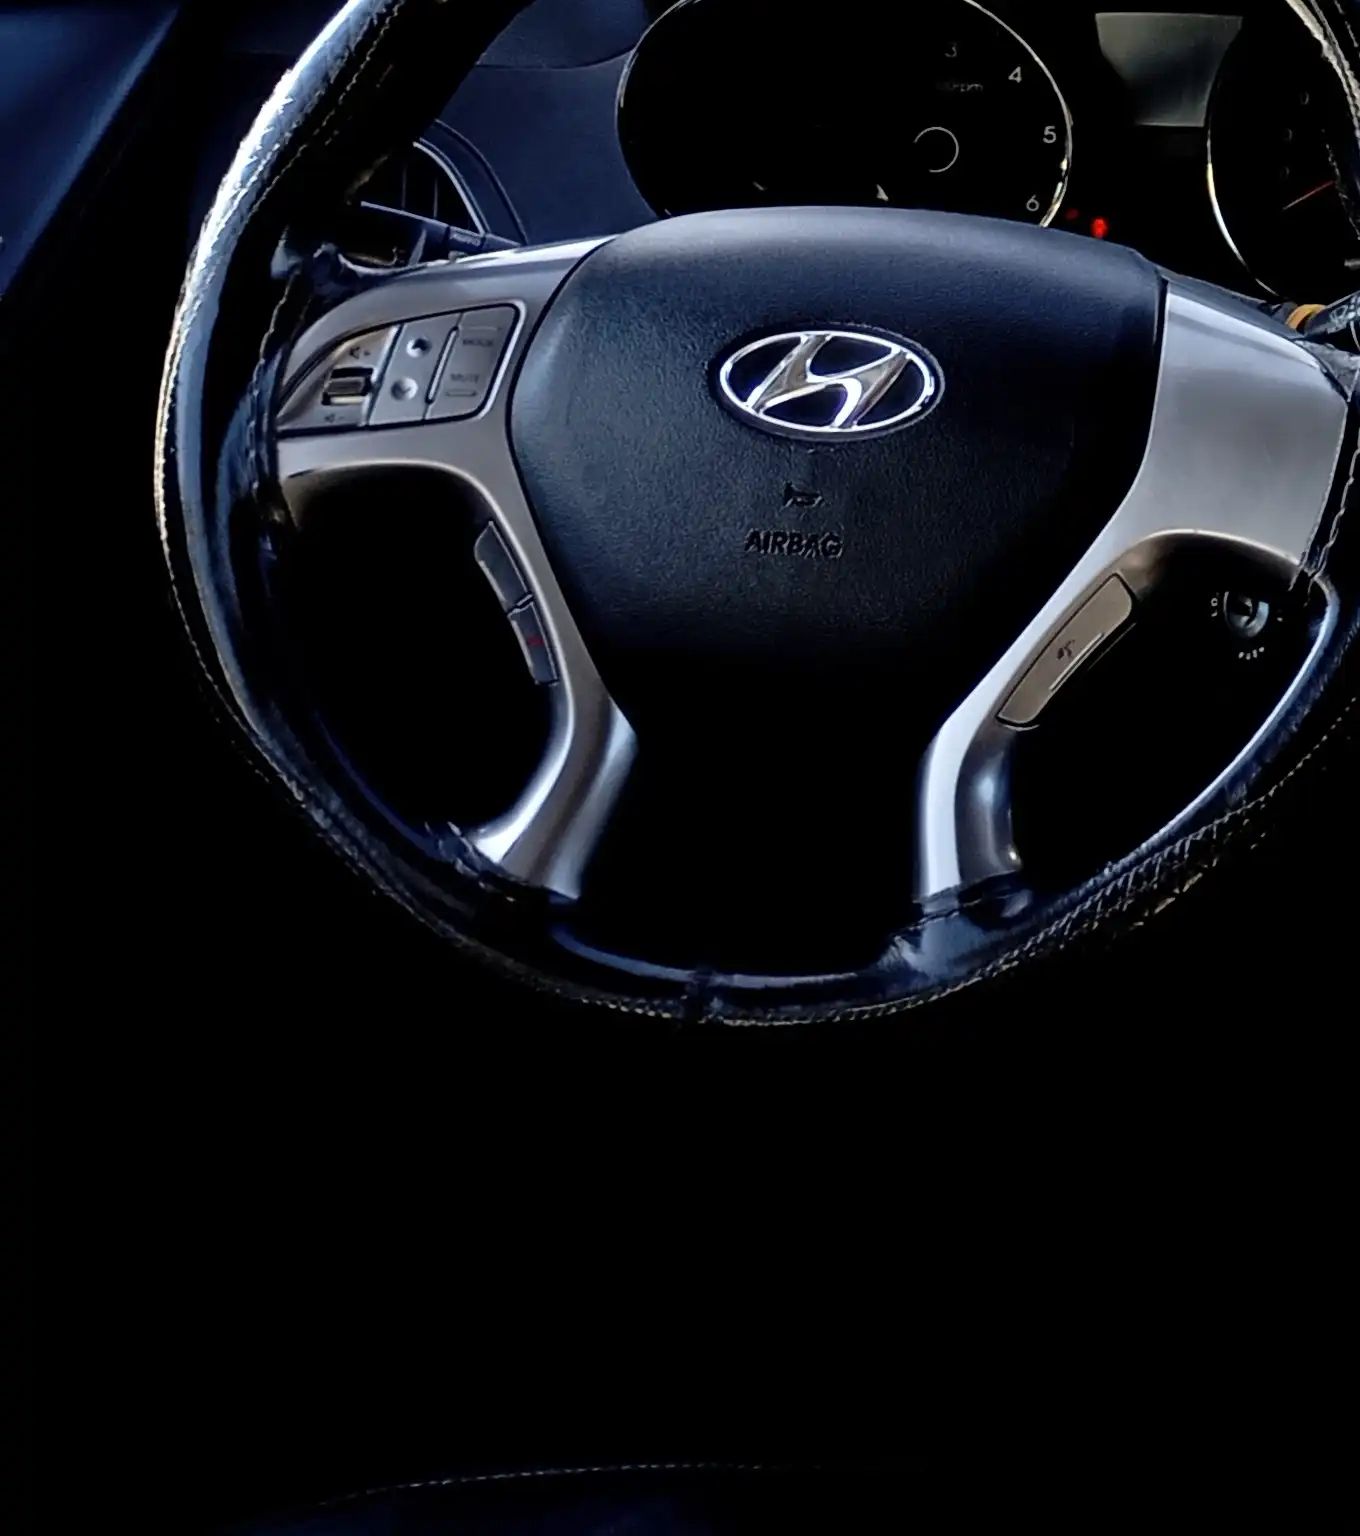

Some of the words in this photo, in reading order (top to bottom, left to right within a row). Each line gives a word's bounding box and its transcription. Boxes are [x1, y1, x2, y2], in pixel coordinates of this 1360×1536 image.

[1008, 66, 1022, 84] 4
[1042, 125, 1057, 144] 5
[1025, 194, 1040, 212] 6
[743, 530, 845, 559] AIRBAG
